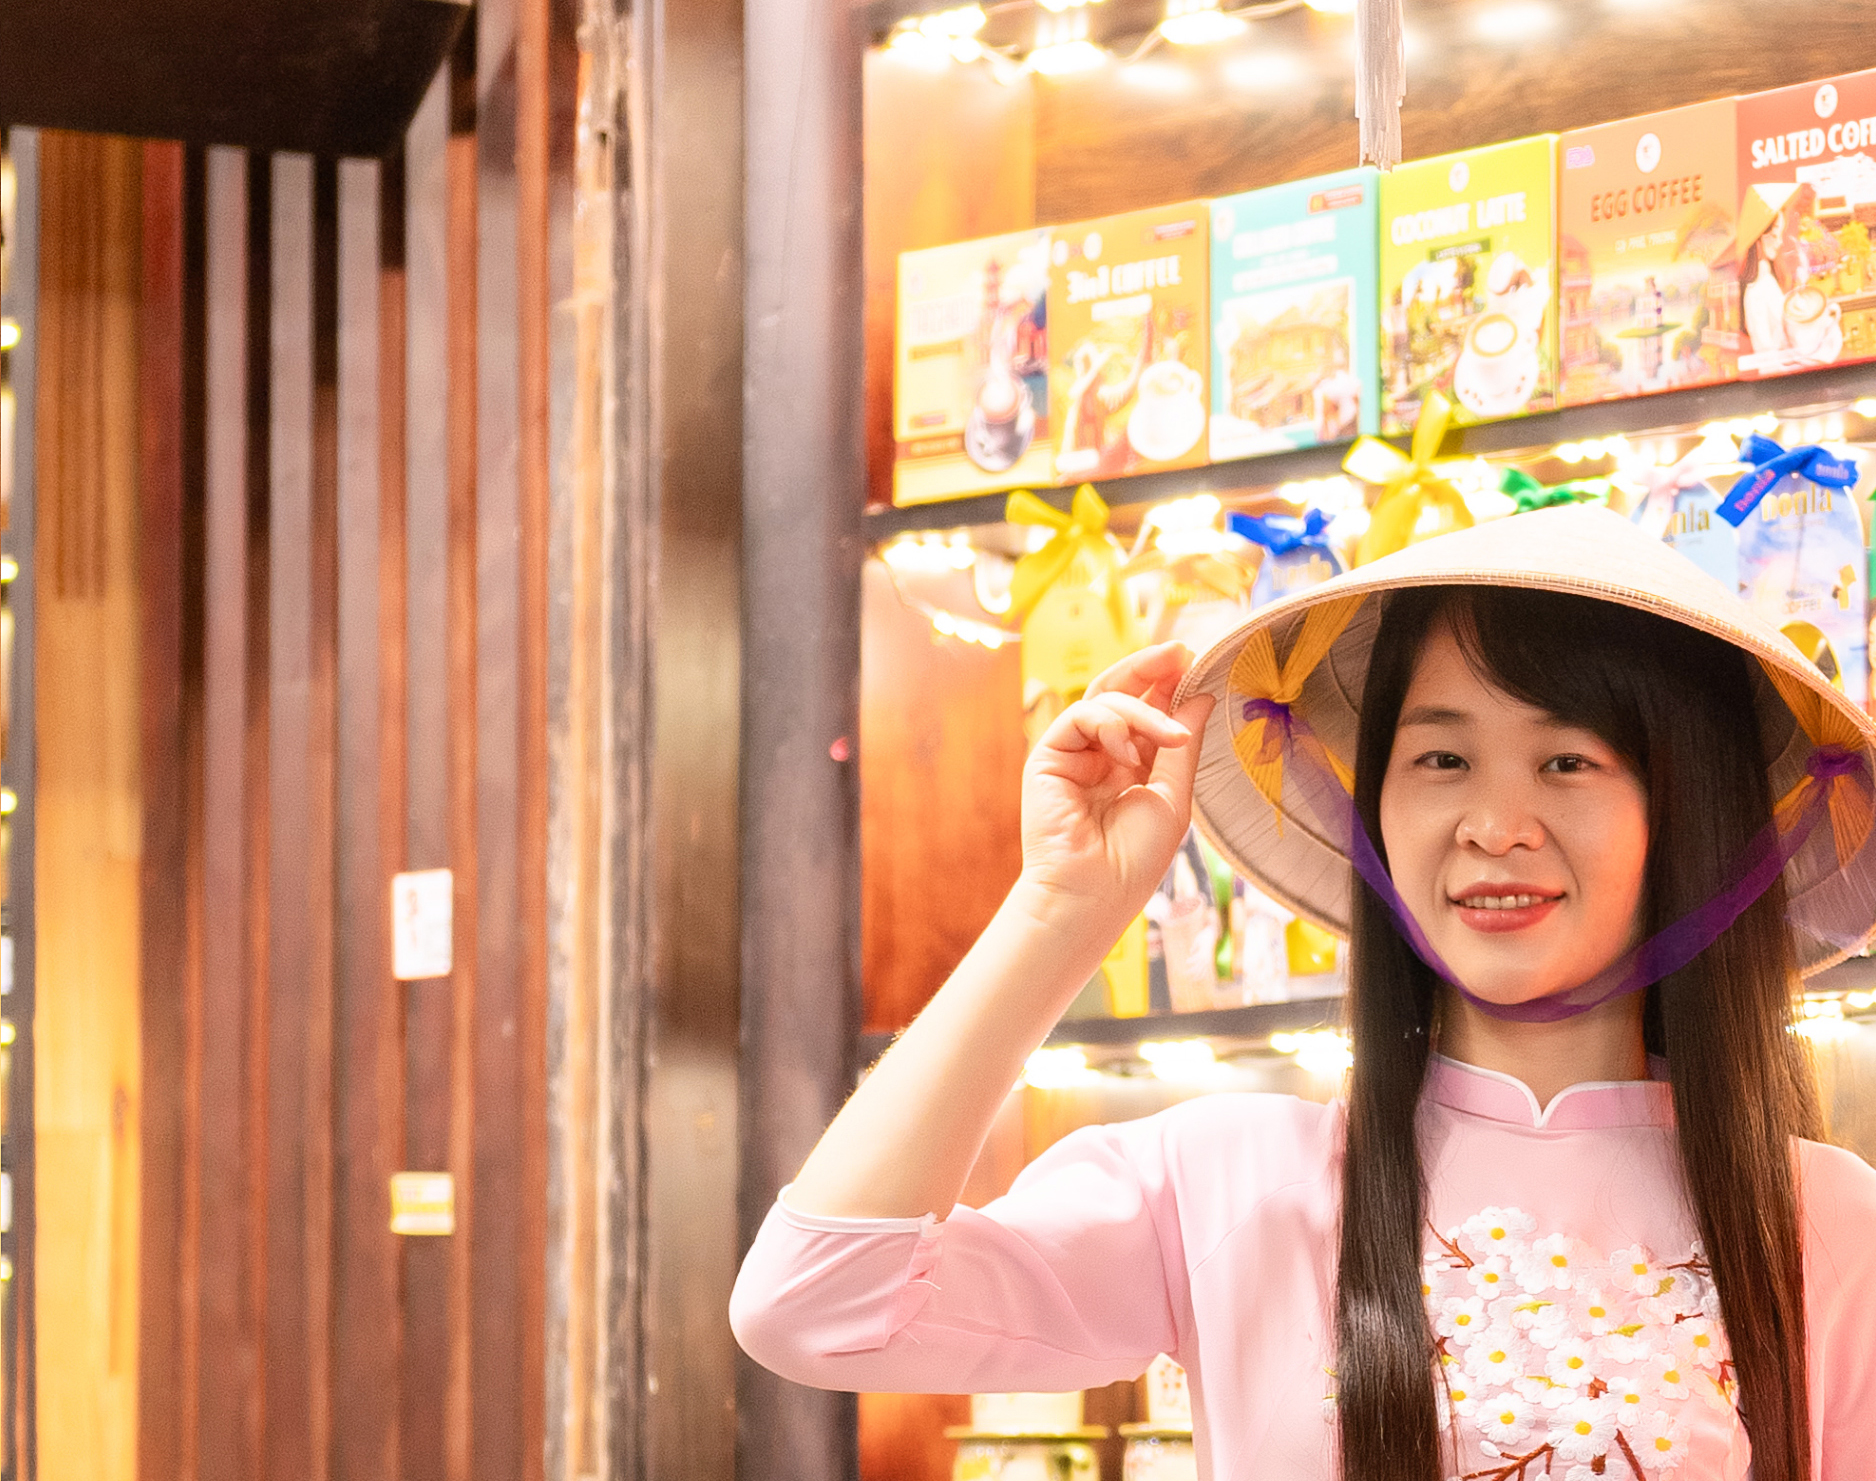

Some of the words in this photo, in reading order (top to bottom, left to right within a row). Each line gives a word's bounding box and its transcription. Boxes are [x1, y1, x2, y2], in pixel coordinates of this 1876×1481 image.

[1751, 128, 1826, 169] SALTED
[1391, 202, 1471, 247] COCONUT
[1476, 191, 1527, 229] LATTE
[1591, 189, 1627, 223] EGG
[1632, 174, 1702, 214] COFFEE
[1111, 254, 1182, 295] COFFEE
[1761, 481, 1833, 522] nonla
